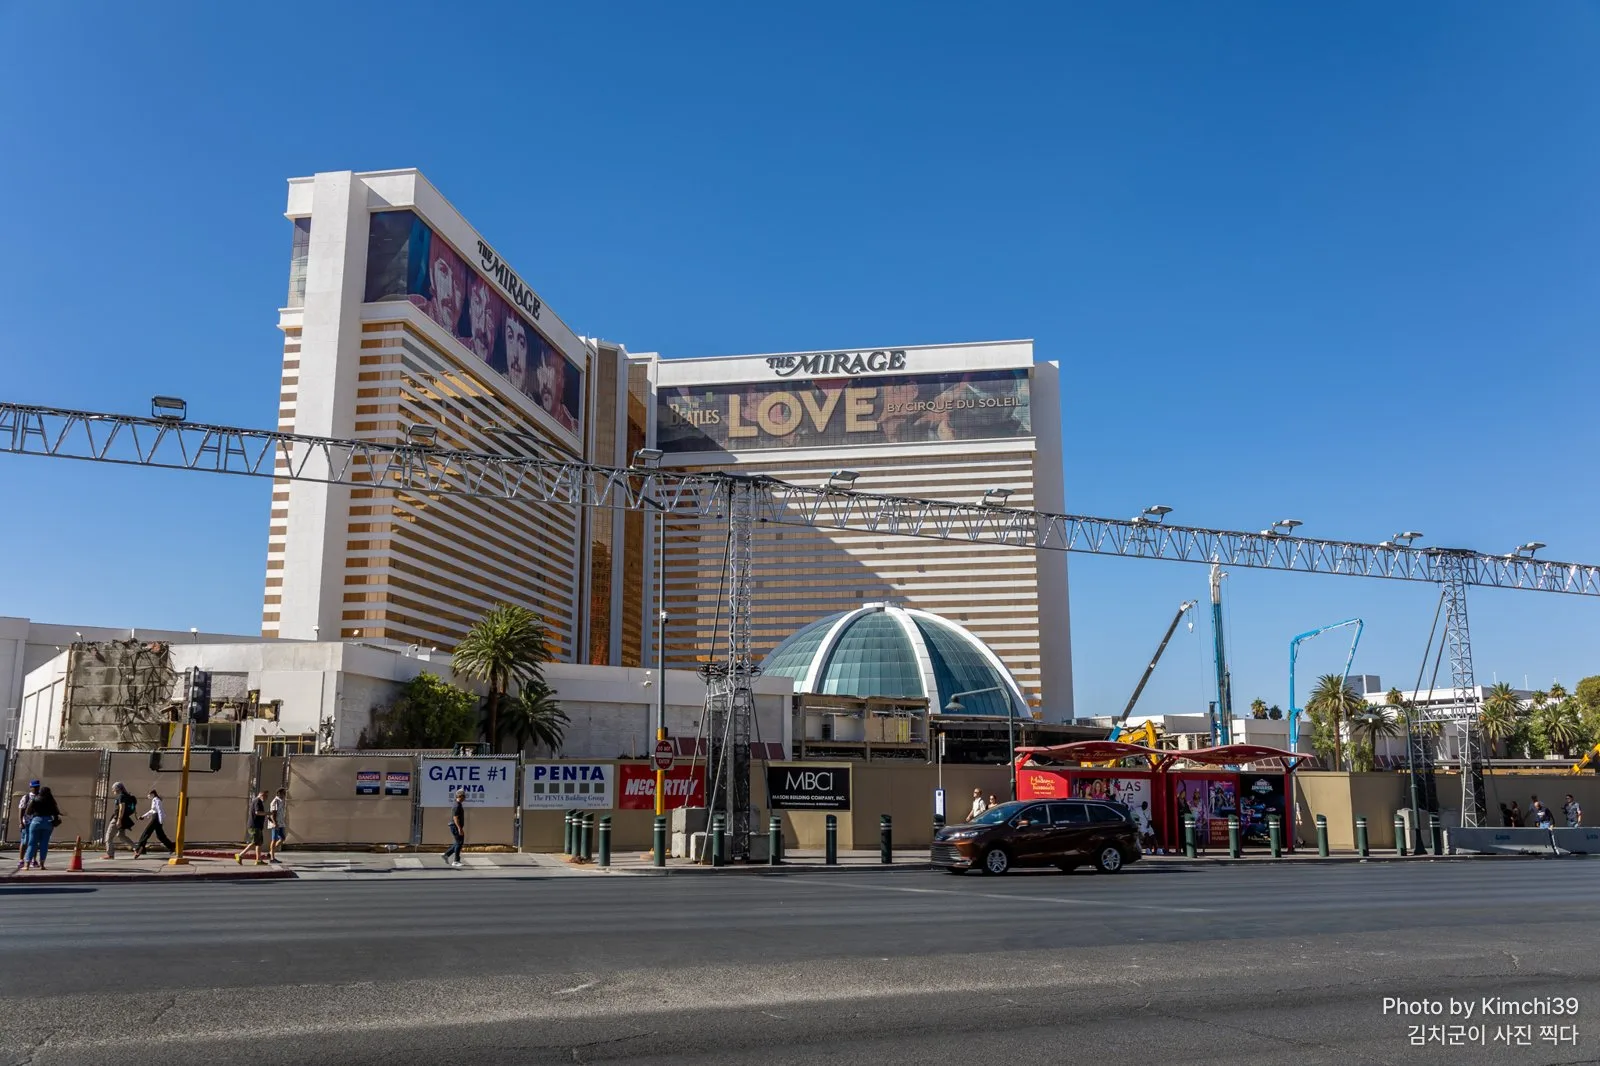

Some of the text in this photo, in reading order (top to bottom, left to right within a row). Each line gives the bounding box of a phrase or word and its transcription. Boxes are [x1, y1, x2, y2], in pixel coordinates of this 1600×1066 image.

[477, 240, 541, 321] THE MIRAGE
[766, 350, 907, 377] THE MIRAGE
[669, 404, 720, 427] BEATLES
[728, 386, 878, 438] LOVE
[887, 403, 904, 412] BY
[905, 400, 953, 413] CIRQUE
[957, 400, 975, 409] DU
[429, 765, 507, 782] GATE #1
[534, 766, 605, 780] PENTA
[785, 771, 833, 791] MBCI
[625, 778, 699, 796] McCRTHY
[565, 795, 587, 803] Building
[588, 795, 605, 803] Group
